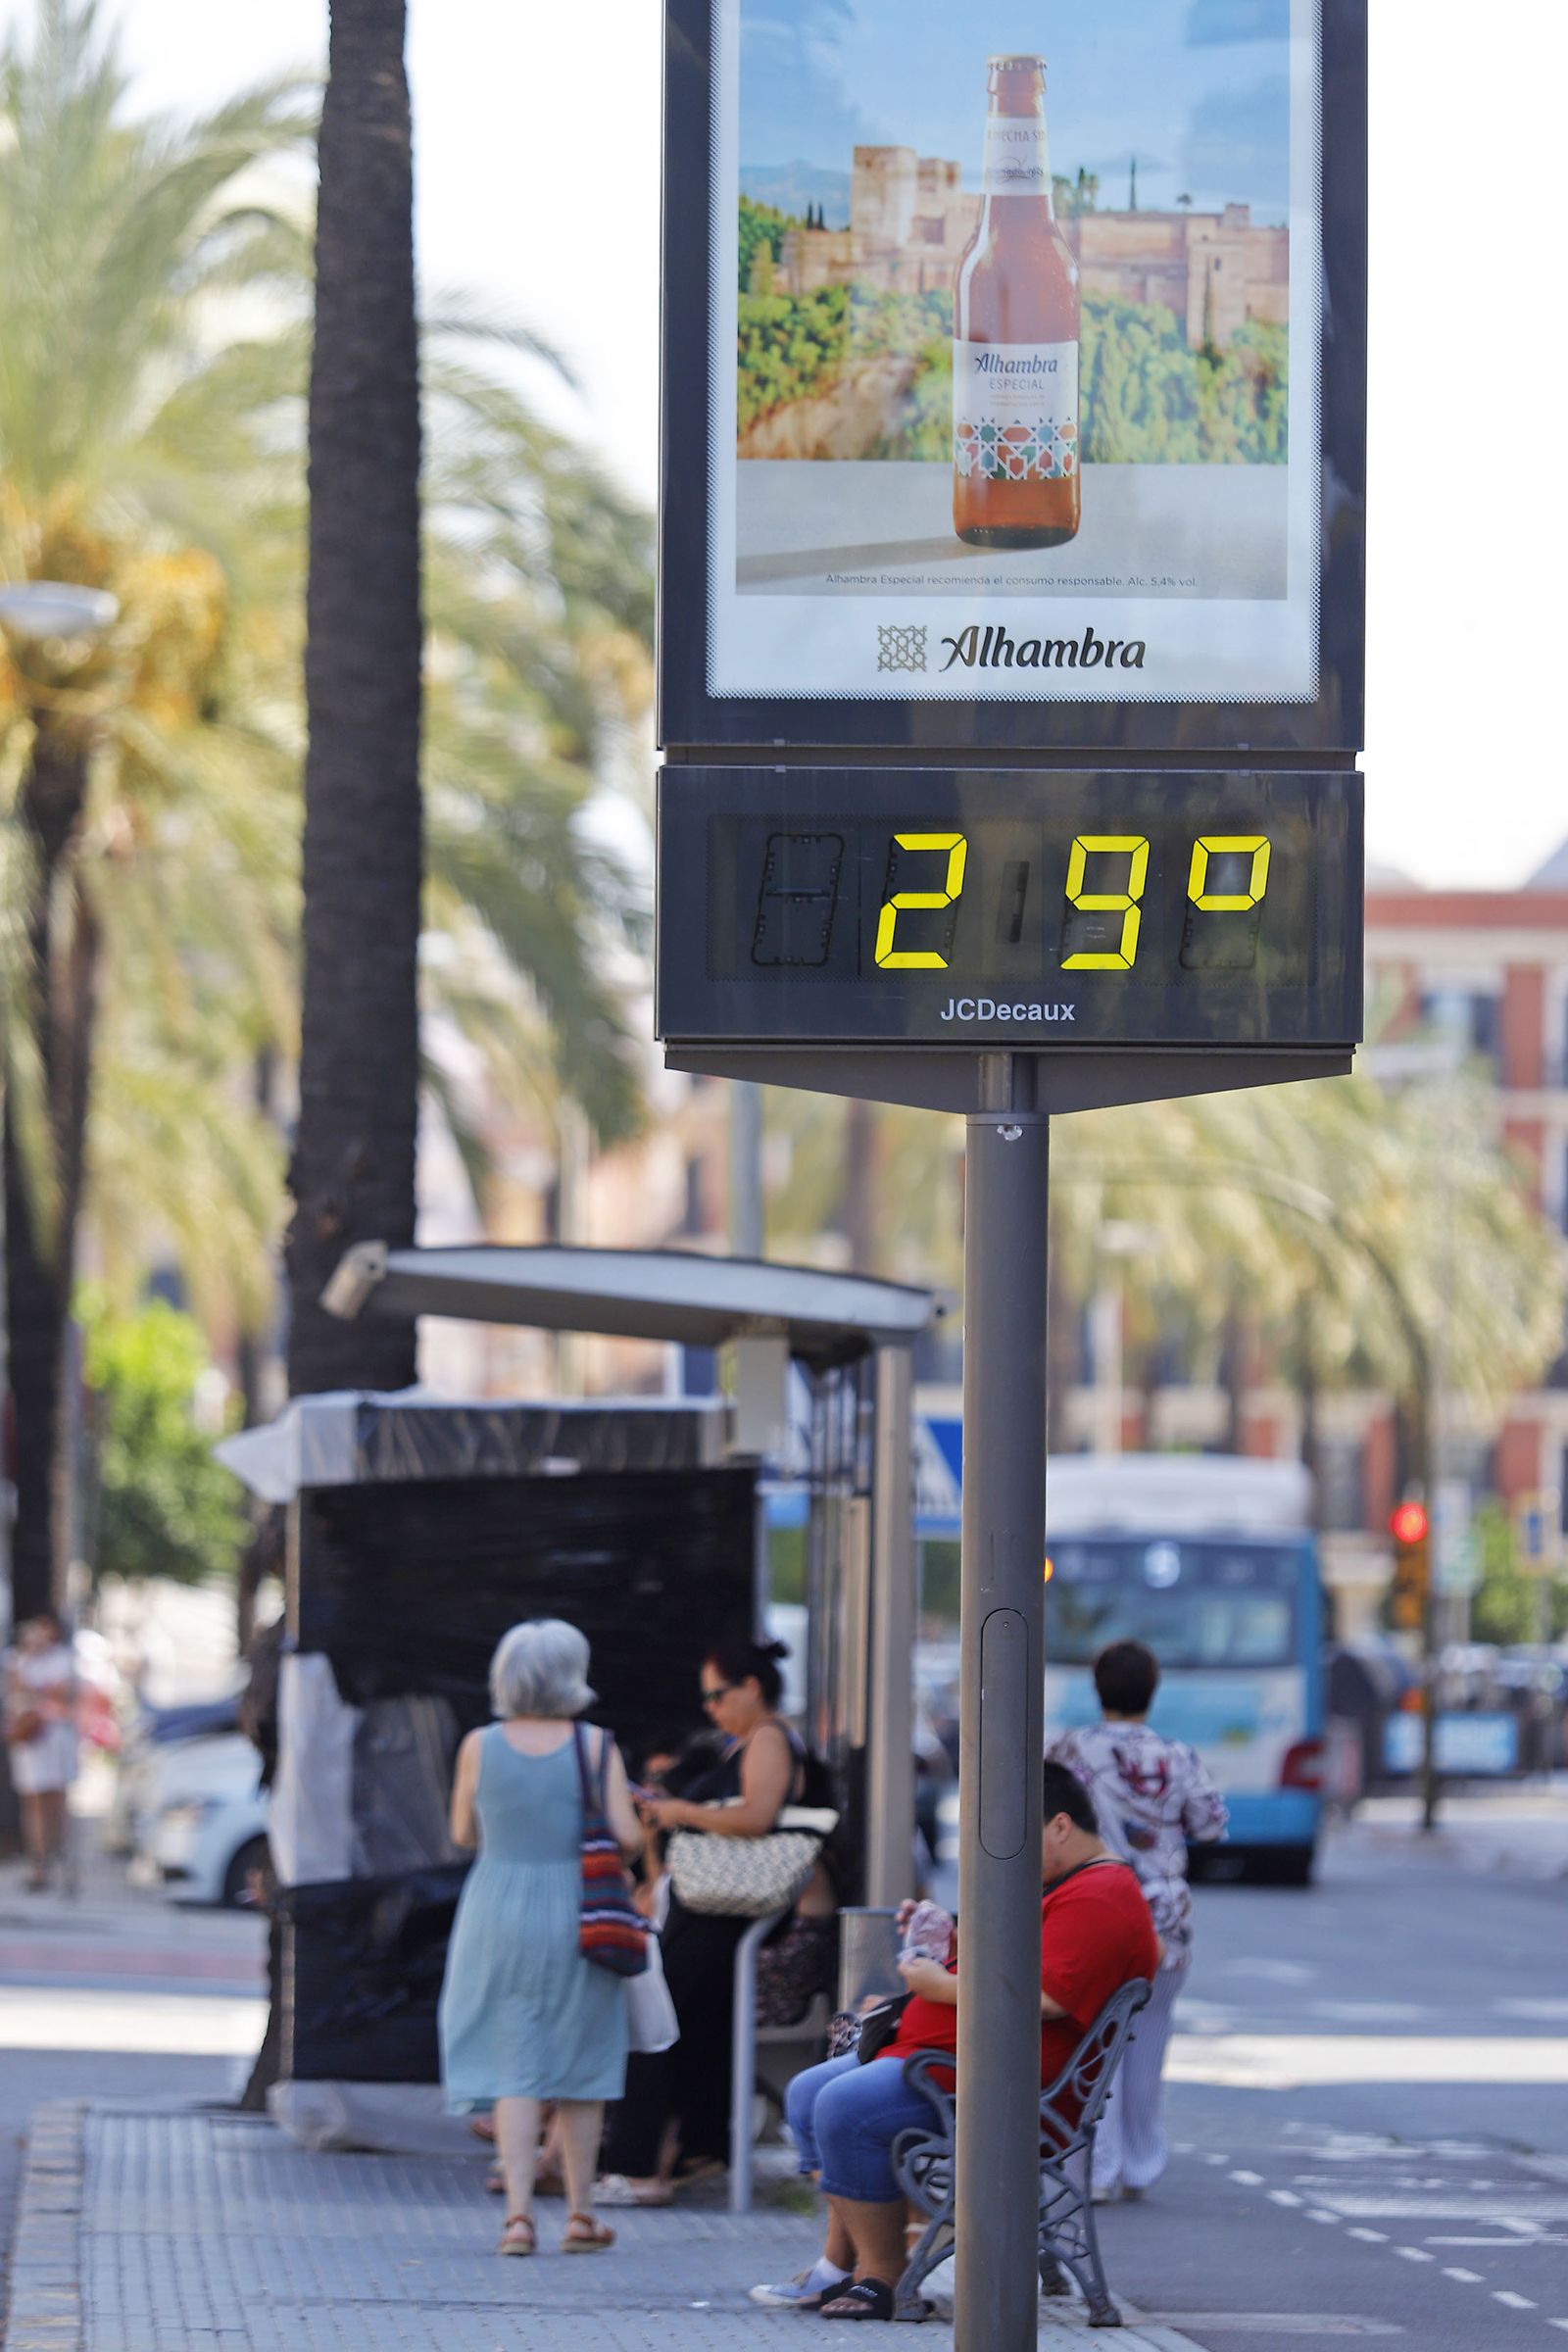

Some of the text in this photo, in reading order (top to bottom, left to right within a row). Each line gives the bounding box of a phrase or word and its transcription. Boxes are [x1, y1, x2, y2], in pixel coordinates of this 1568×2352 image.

[975, 353, 1058, 374] Alhambra
[990, 378, 1045, 391] ESPECIAL
[825, 573, 878, 585] Alhambra
[881, 574, 924, 587] Especial
[927, 573, 990, 586] recomienda
[994, 574, 1004, 585] el
[1005, 576, 1054, 586] consumo
[938, 625, 1147, 672] Alhambra
[940, 998, 1076, 1021] JCDecaux
